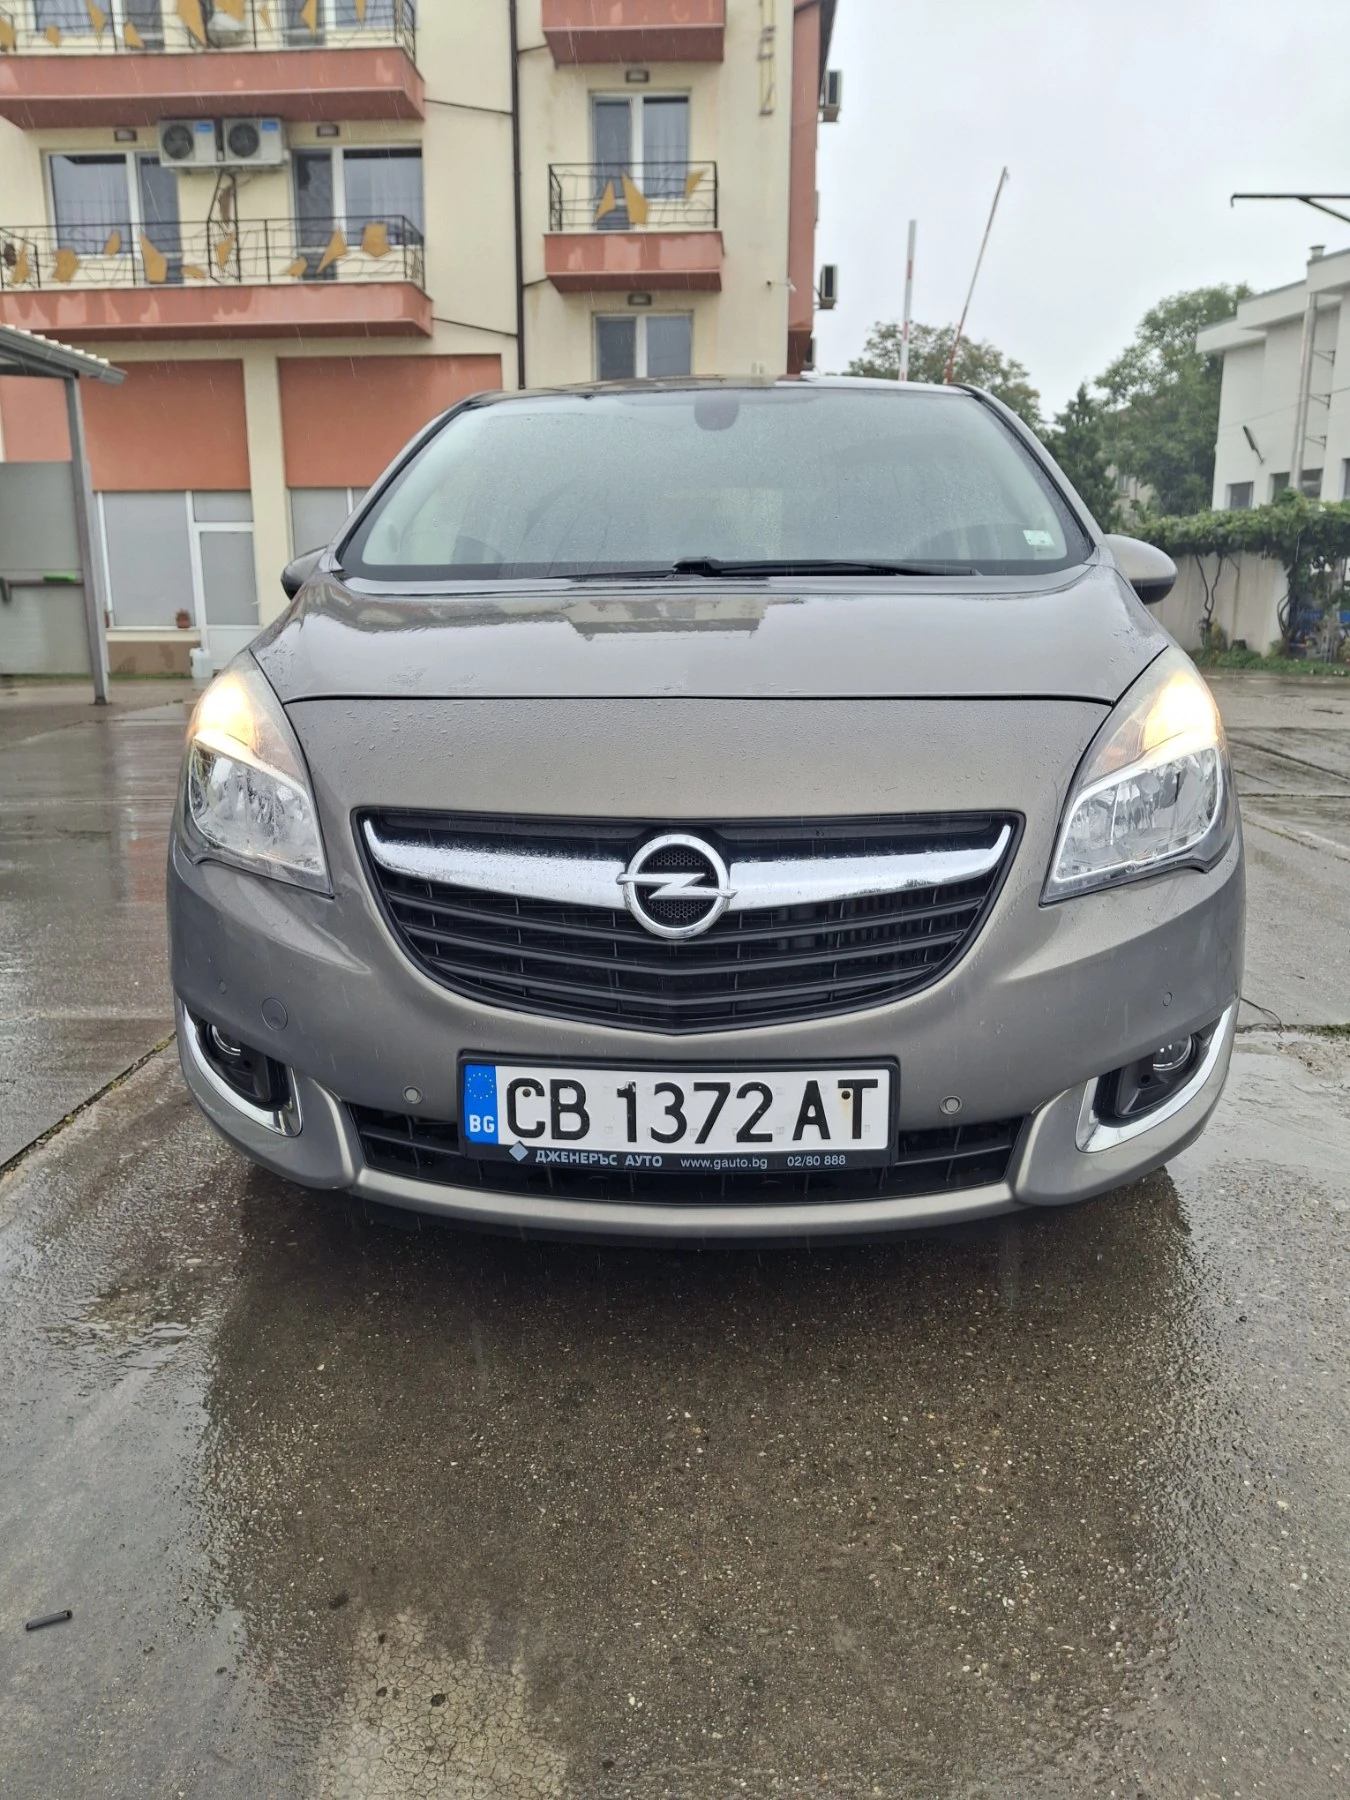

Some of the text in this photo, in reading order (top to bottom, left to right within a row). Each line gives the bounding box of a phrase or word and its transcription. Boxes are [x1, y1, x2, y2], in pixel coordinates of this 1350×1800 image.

[507, 1078, 878, 1144] CB 1372 AT
[468, 1115, 495, 1134] BG
[625, 1155, 663, 1167] АУТО
[680, 1156, 768, 1169] www.gauto.bg
[785, 1154, 846, 1167] 02/80 888
